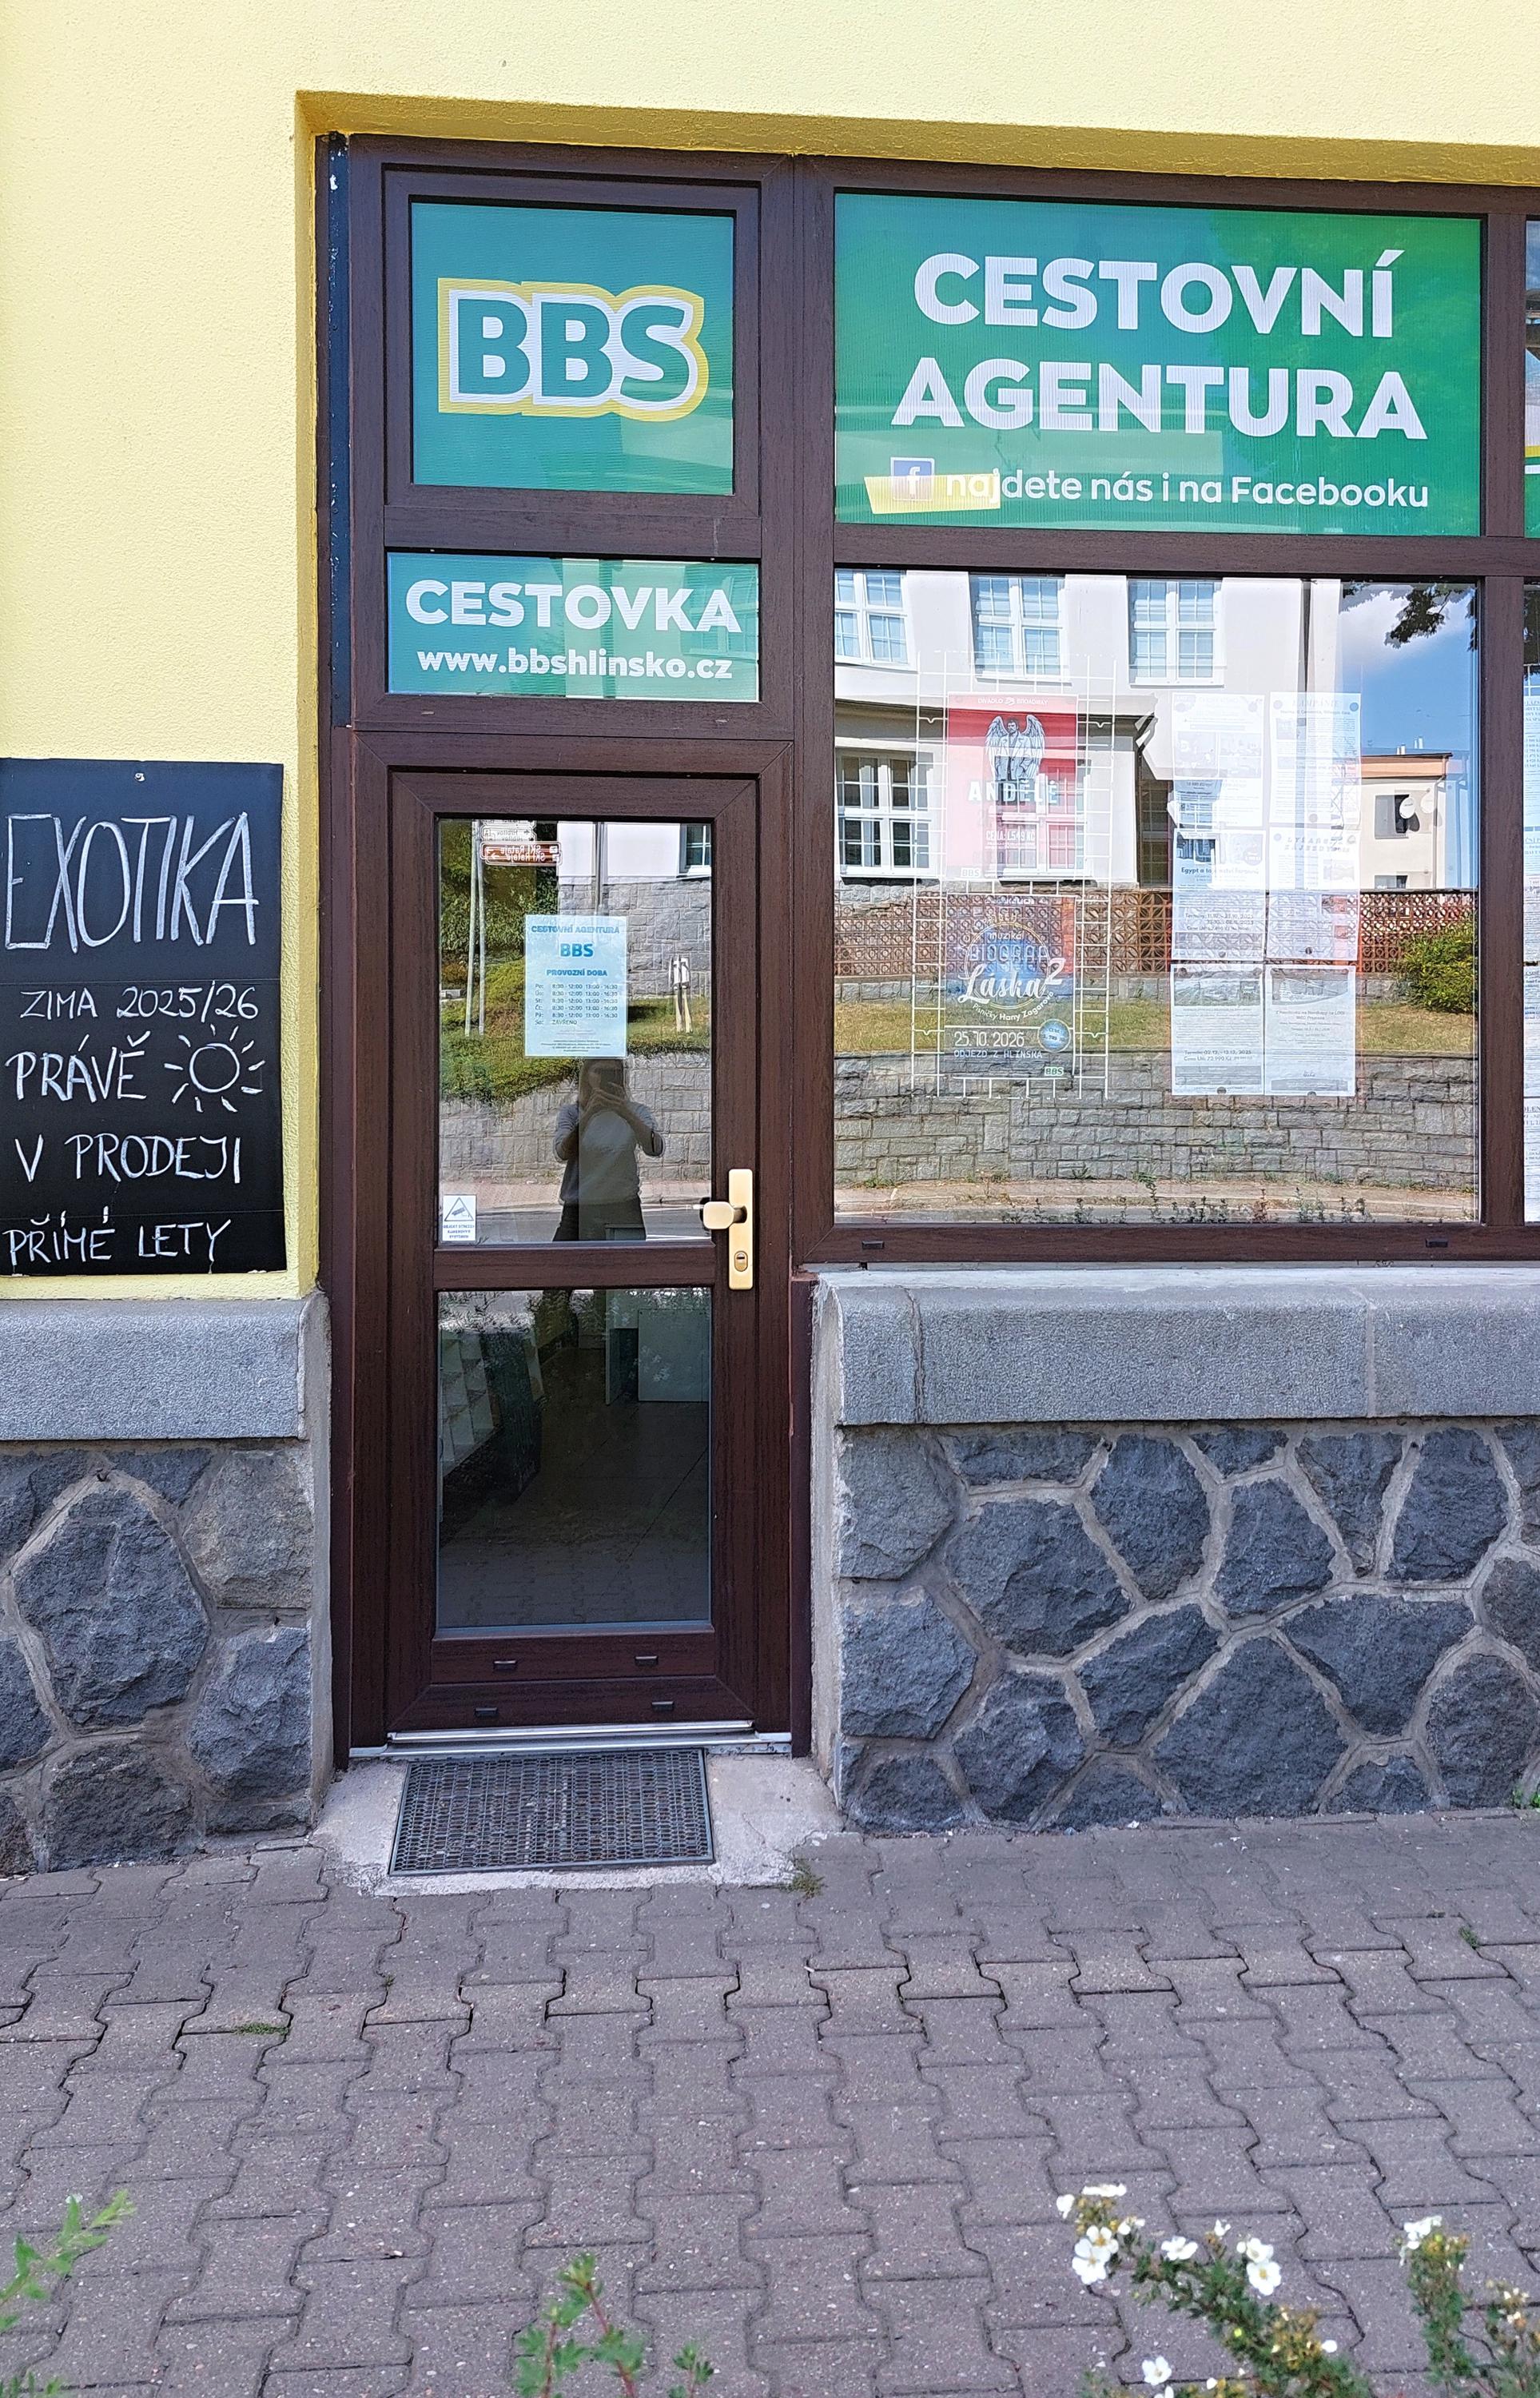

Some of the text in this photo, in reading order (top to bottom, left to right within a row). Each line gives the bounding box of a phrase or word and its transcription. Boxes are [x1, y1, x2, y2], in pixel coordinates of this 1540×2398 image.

[913, 249, 1406, 339] CESTOVNÍ
[449, 289, 697, 412] BBS
[890, 357, 1428, 440] AGENTURA
[945, 468, 1082, 511] najdete
[1091, 471, 1153, 501] nás
[1161, 472, 1170, 502] i
[1179, 480, 1223, 504] na
[1232, 476, 1430, 508] Facebooku
[405, 579, 742, 633] CESTOVKA
[416, 647, 733, 679] www.bbshlinsko.cz
[3, 810, 261, 954] EXOTIKA
[961, 868, 980, 878] BBS
[531, 924, 620, 934] CESTOVNÍ AGENTURA
[559, 942, 595, 958] BBS
[988, 930, 1025, 940] muzikál
[546, 968, 585, 977] PROVOZNÍ
[957, 958, 1067, 1004] Láska 2
[20, 980, 259, 1023] ZIMA 2025/26
[999, 1014, 1021, 1022] Hany
[953, 1050, 989, 1058] ODJEZD
[1003, 1050, 1044, 1059] HLINSKA
[993, 1031, 1025, 1047] 2026
[5, 1030, 152, 1104] PRÁVĚ
[1045, 1066, 1064, 1076] BBS
[14, 1133, 241, 1185] V PRODEJI
[2, 1205, 232, 1266] PŘÍMÉ LETY
